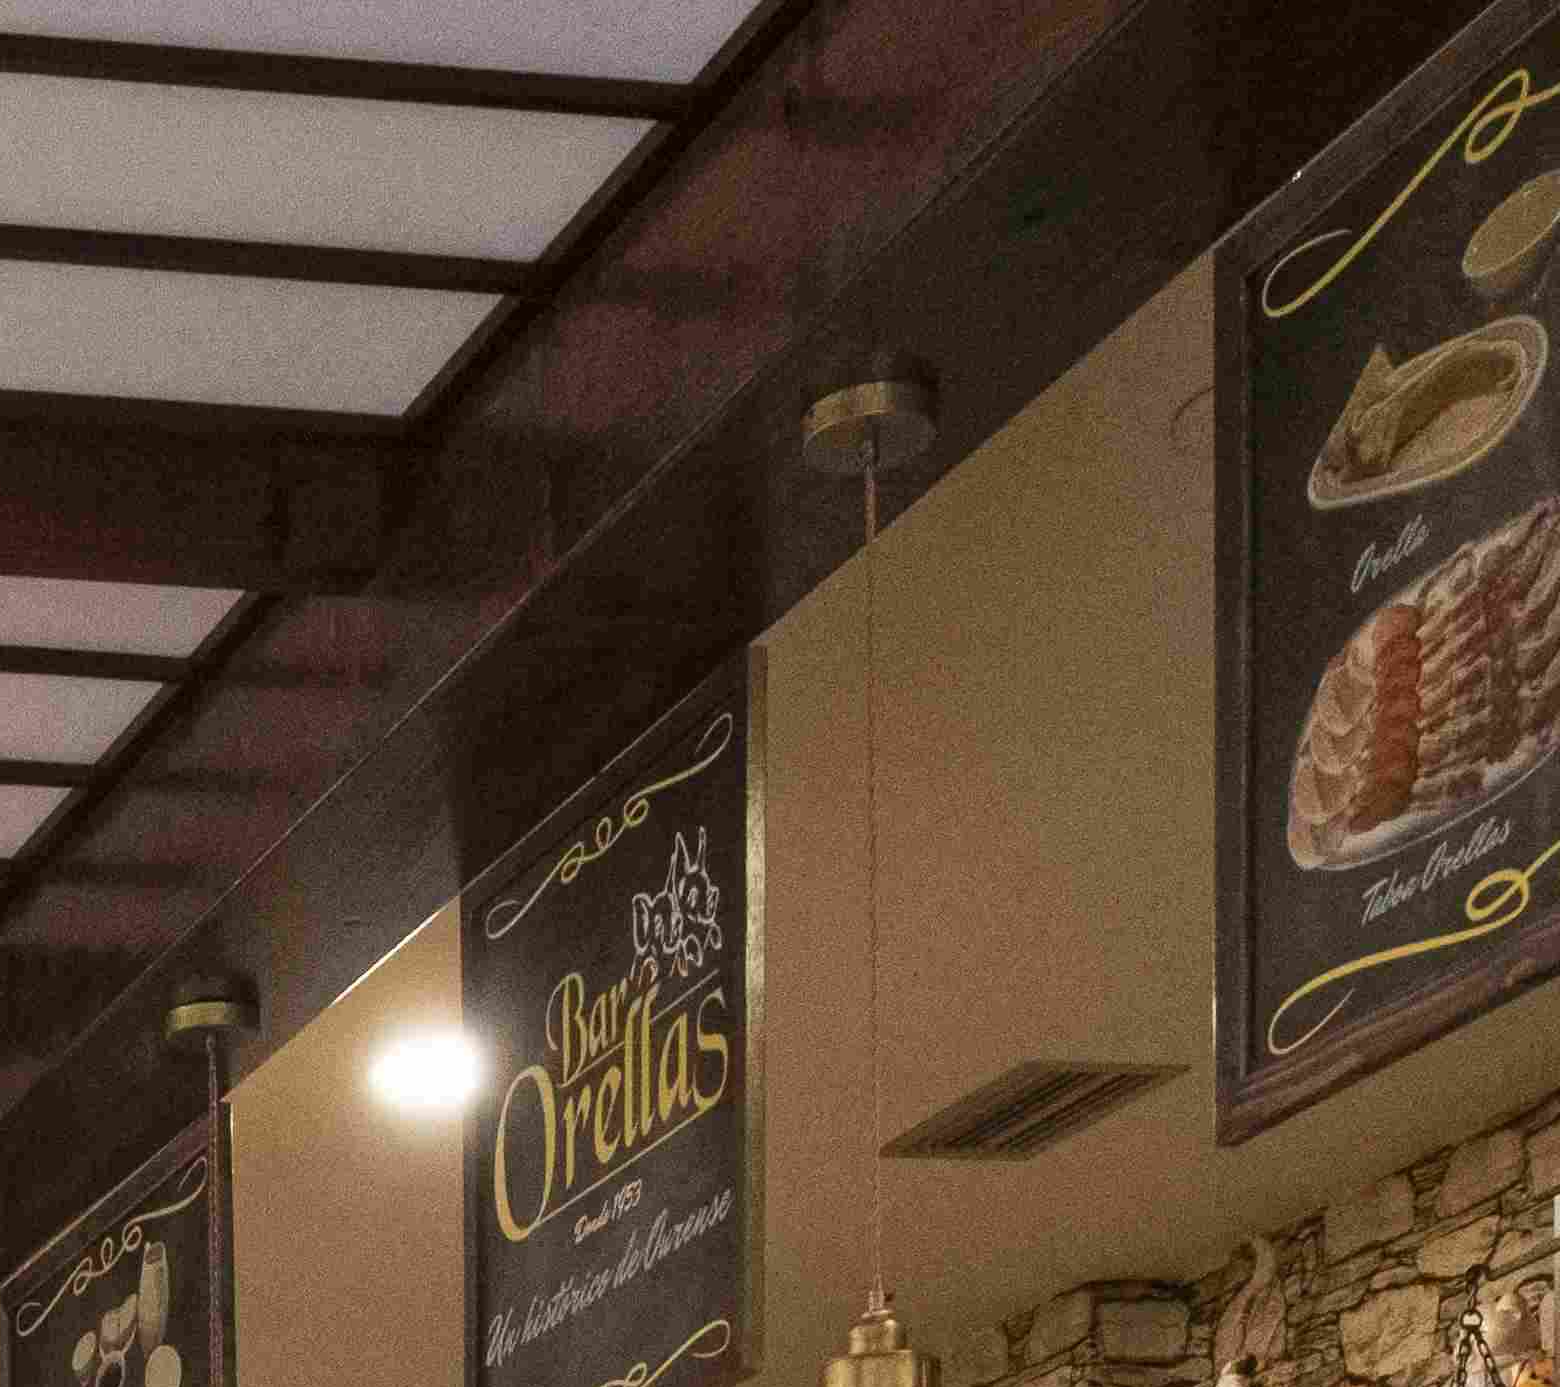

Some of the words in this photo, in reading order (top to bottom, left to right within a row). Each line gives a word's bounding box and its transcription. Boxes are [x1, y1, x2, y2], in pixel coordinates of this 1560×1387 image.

[545, 972, 627, 1087] Bar
[494, 985, 729, 1242] Orellas
[613, 1231, 642, 1288] de
[644, 1188, 732, 1270] Ourense
